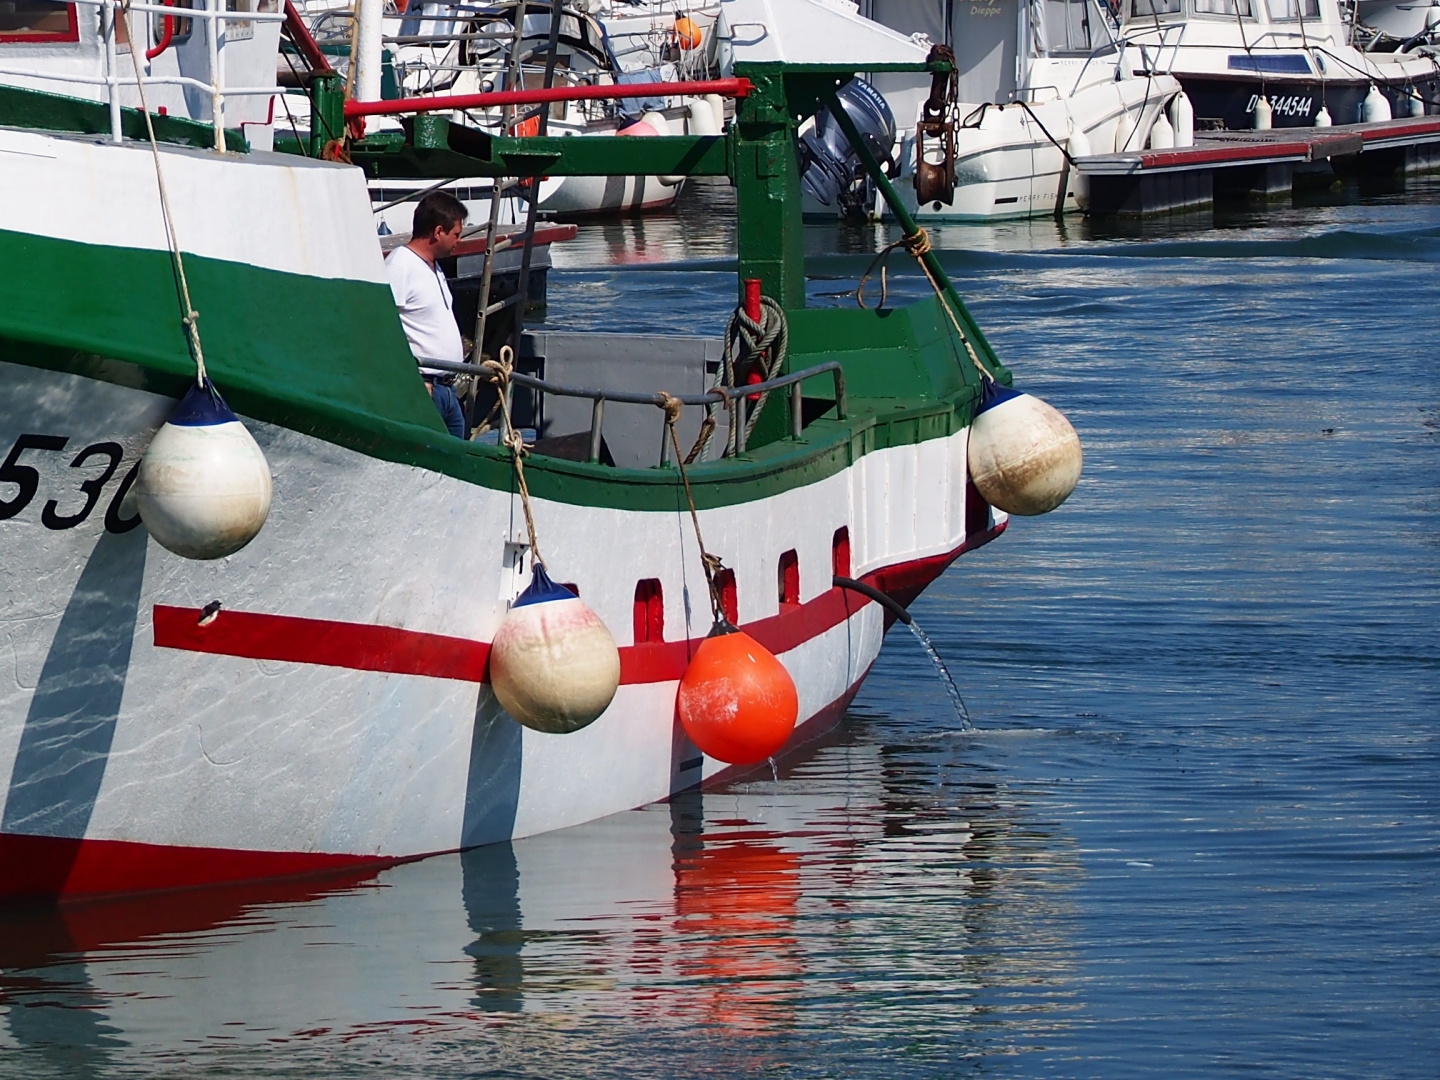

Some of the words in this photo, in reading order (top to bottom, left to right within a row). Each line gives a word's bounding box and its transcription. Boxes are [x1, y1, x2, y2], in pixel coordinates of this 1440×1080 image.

[970, 5, 1001, 17] Dieppe
[857, 80, 885, 109] YAMAHA
[1271, 95, 1312, 117] 344544
